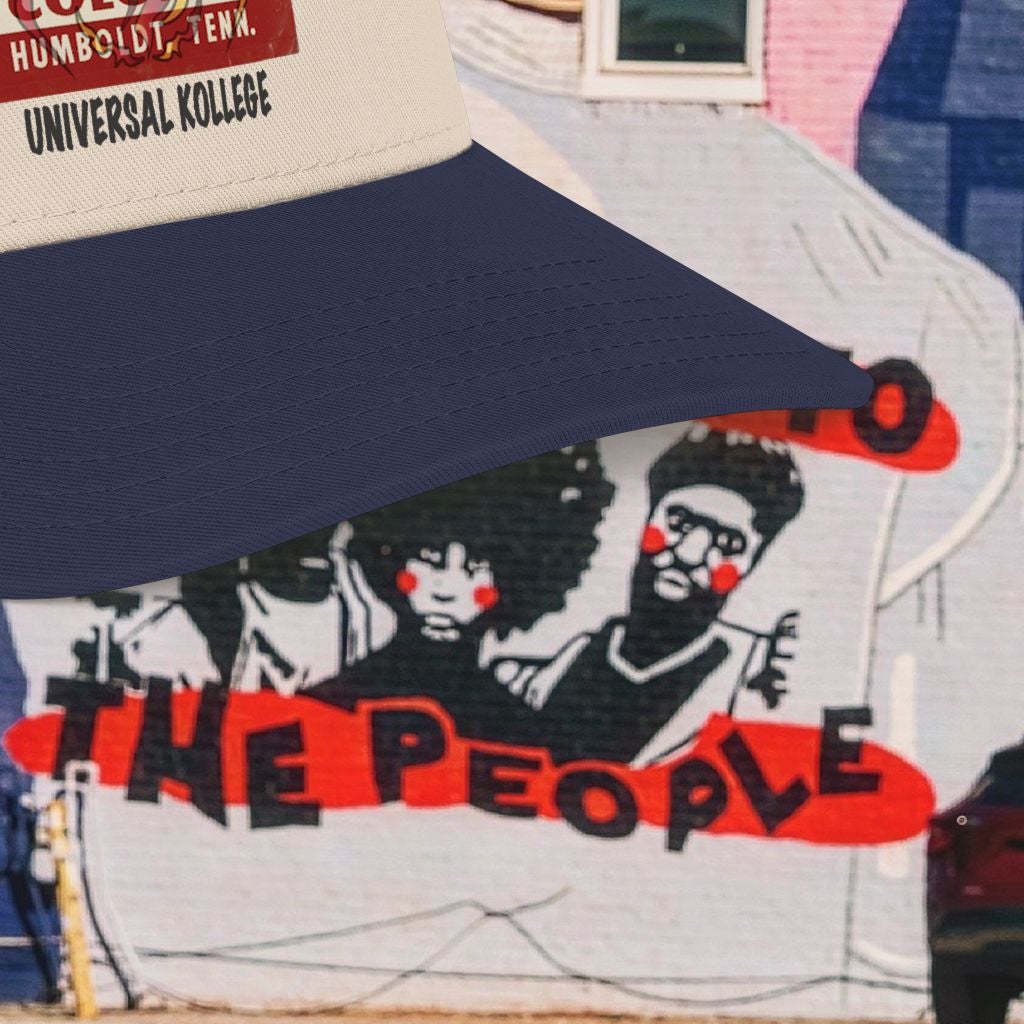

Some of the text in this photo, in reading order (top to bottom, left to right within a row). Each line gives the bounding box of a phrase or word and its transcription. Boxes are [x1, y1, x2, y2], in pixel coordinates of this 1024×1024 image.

[186, 8, 256, 45] TENN.
[24, 69, 272, 155] UNIVERSAL KOLLEGE
[46, 676, 881, 852] THE PEOPLE
